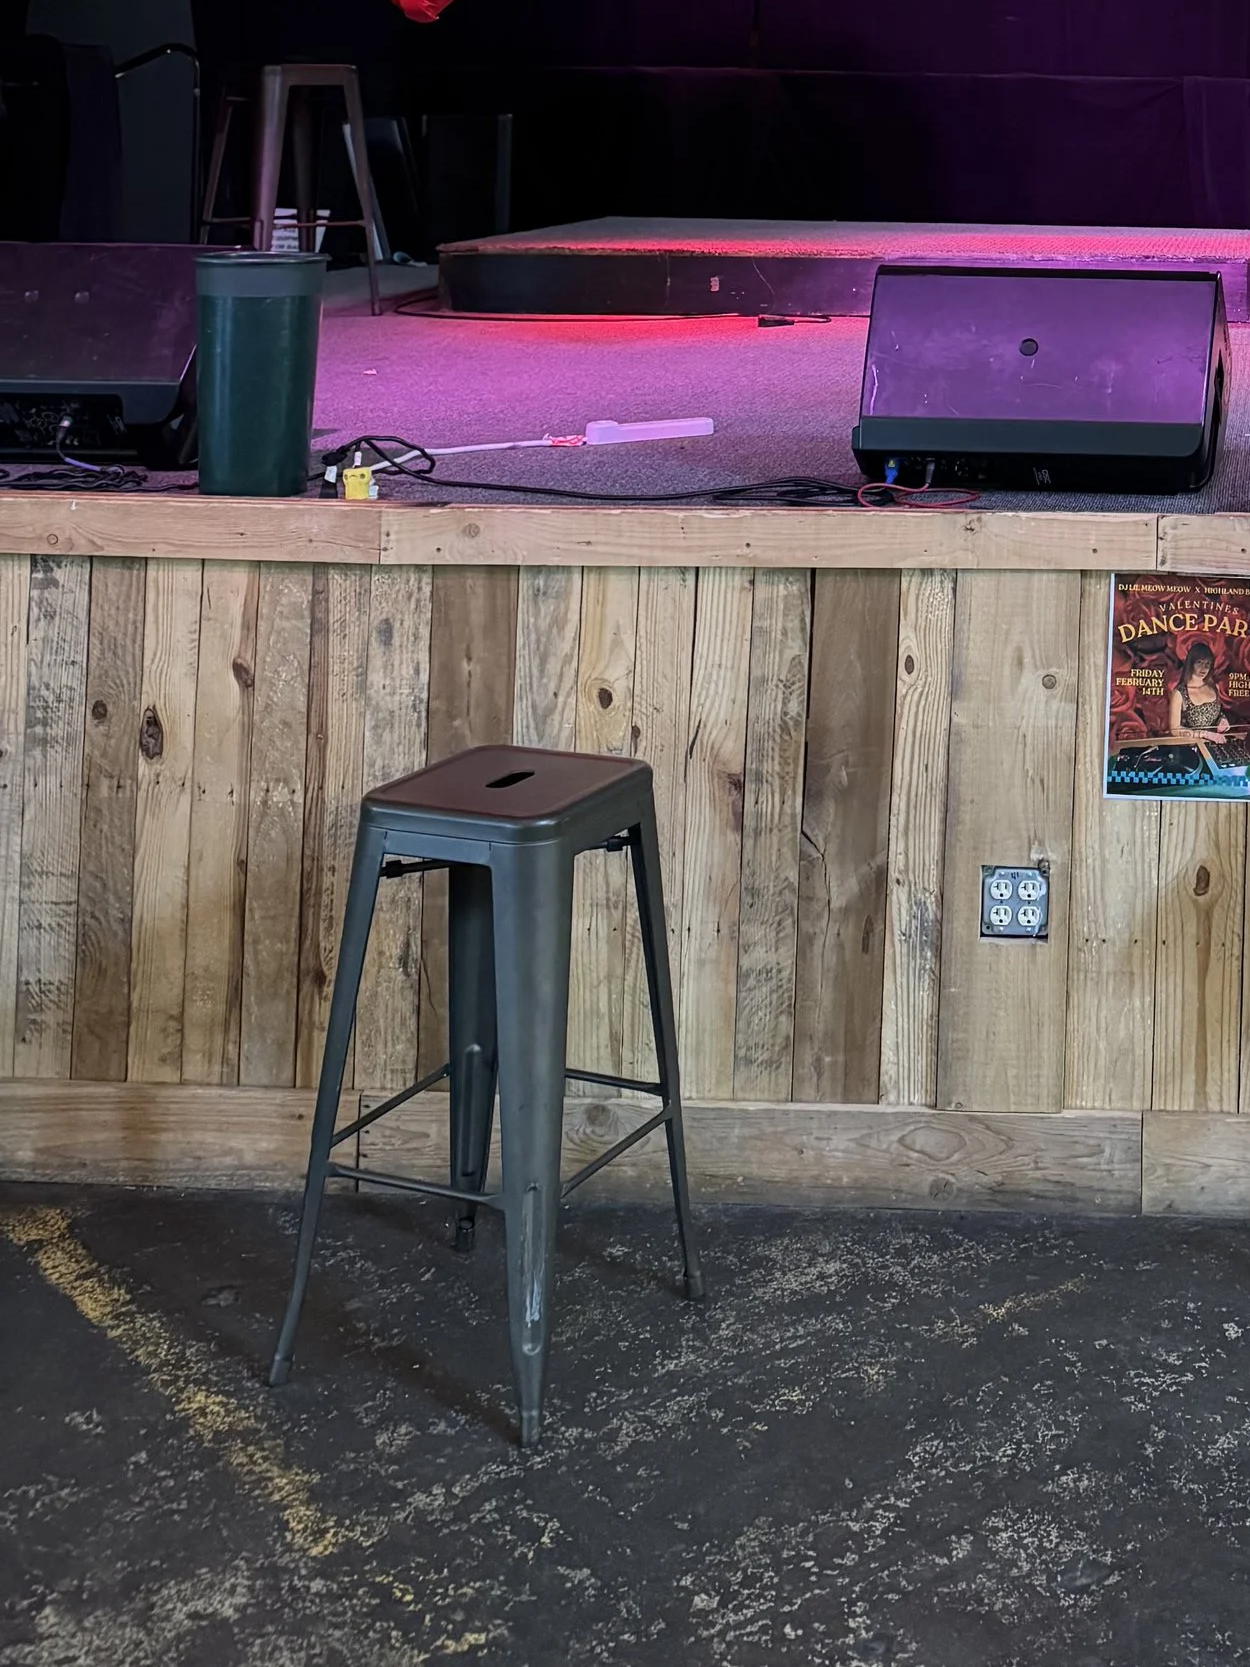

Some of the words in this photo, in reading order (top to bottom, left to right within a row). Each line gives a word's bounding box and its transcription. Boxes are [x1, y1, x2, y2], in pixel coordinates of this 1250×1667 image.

[1141, 584, 1165, 592] MEOW
[1166, 585, 1191, 593] MEOW
[1204, 587, 1244, 595] HIGHLAND
[1159, 600, 1240, 615] VALENTINES
[1118, 614, 1198, 643] DANCE
[1130, 668, 1165, 678] FRIDAY
[1116, 677, 1165, 687] FEBRUARY
[1142, 687, 1164, 696] 14TH
[1228, 689, 1250, 697] FREE
